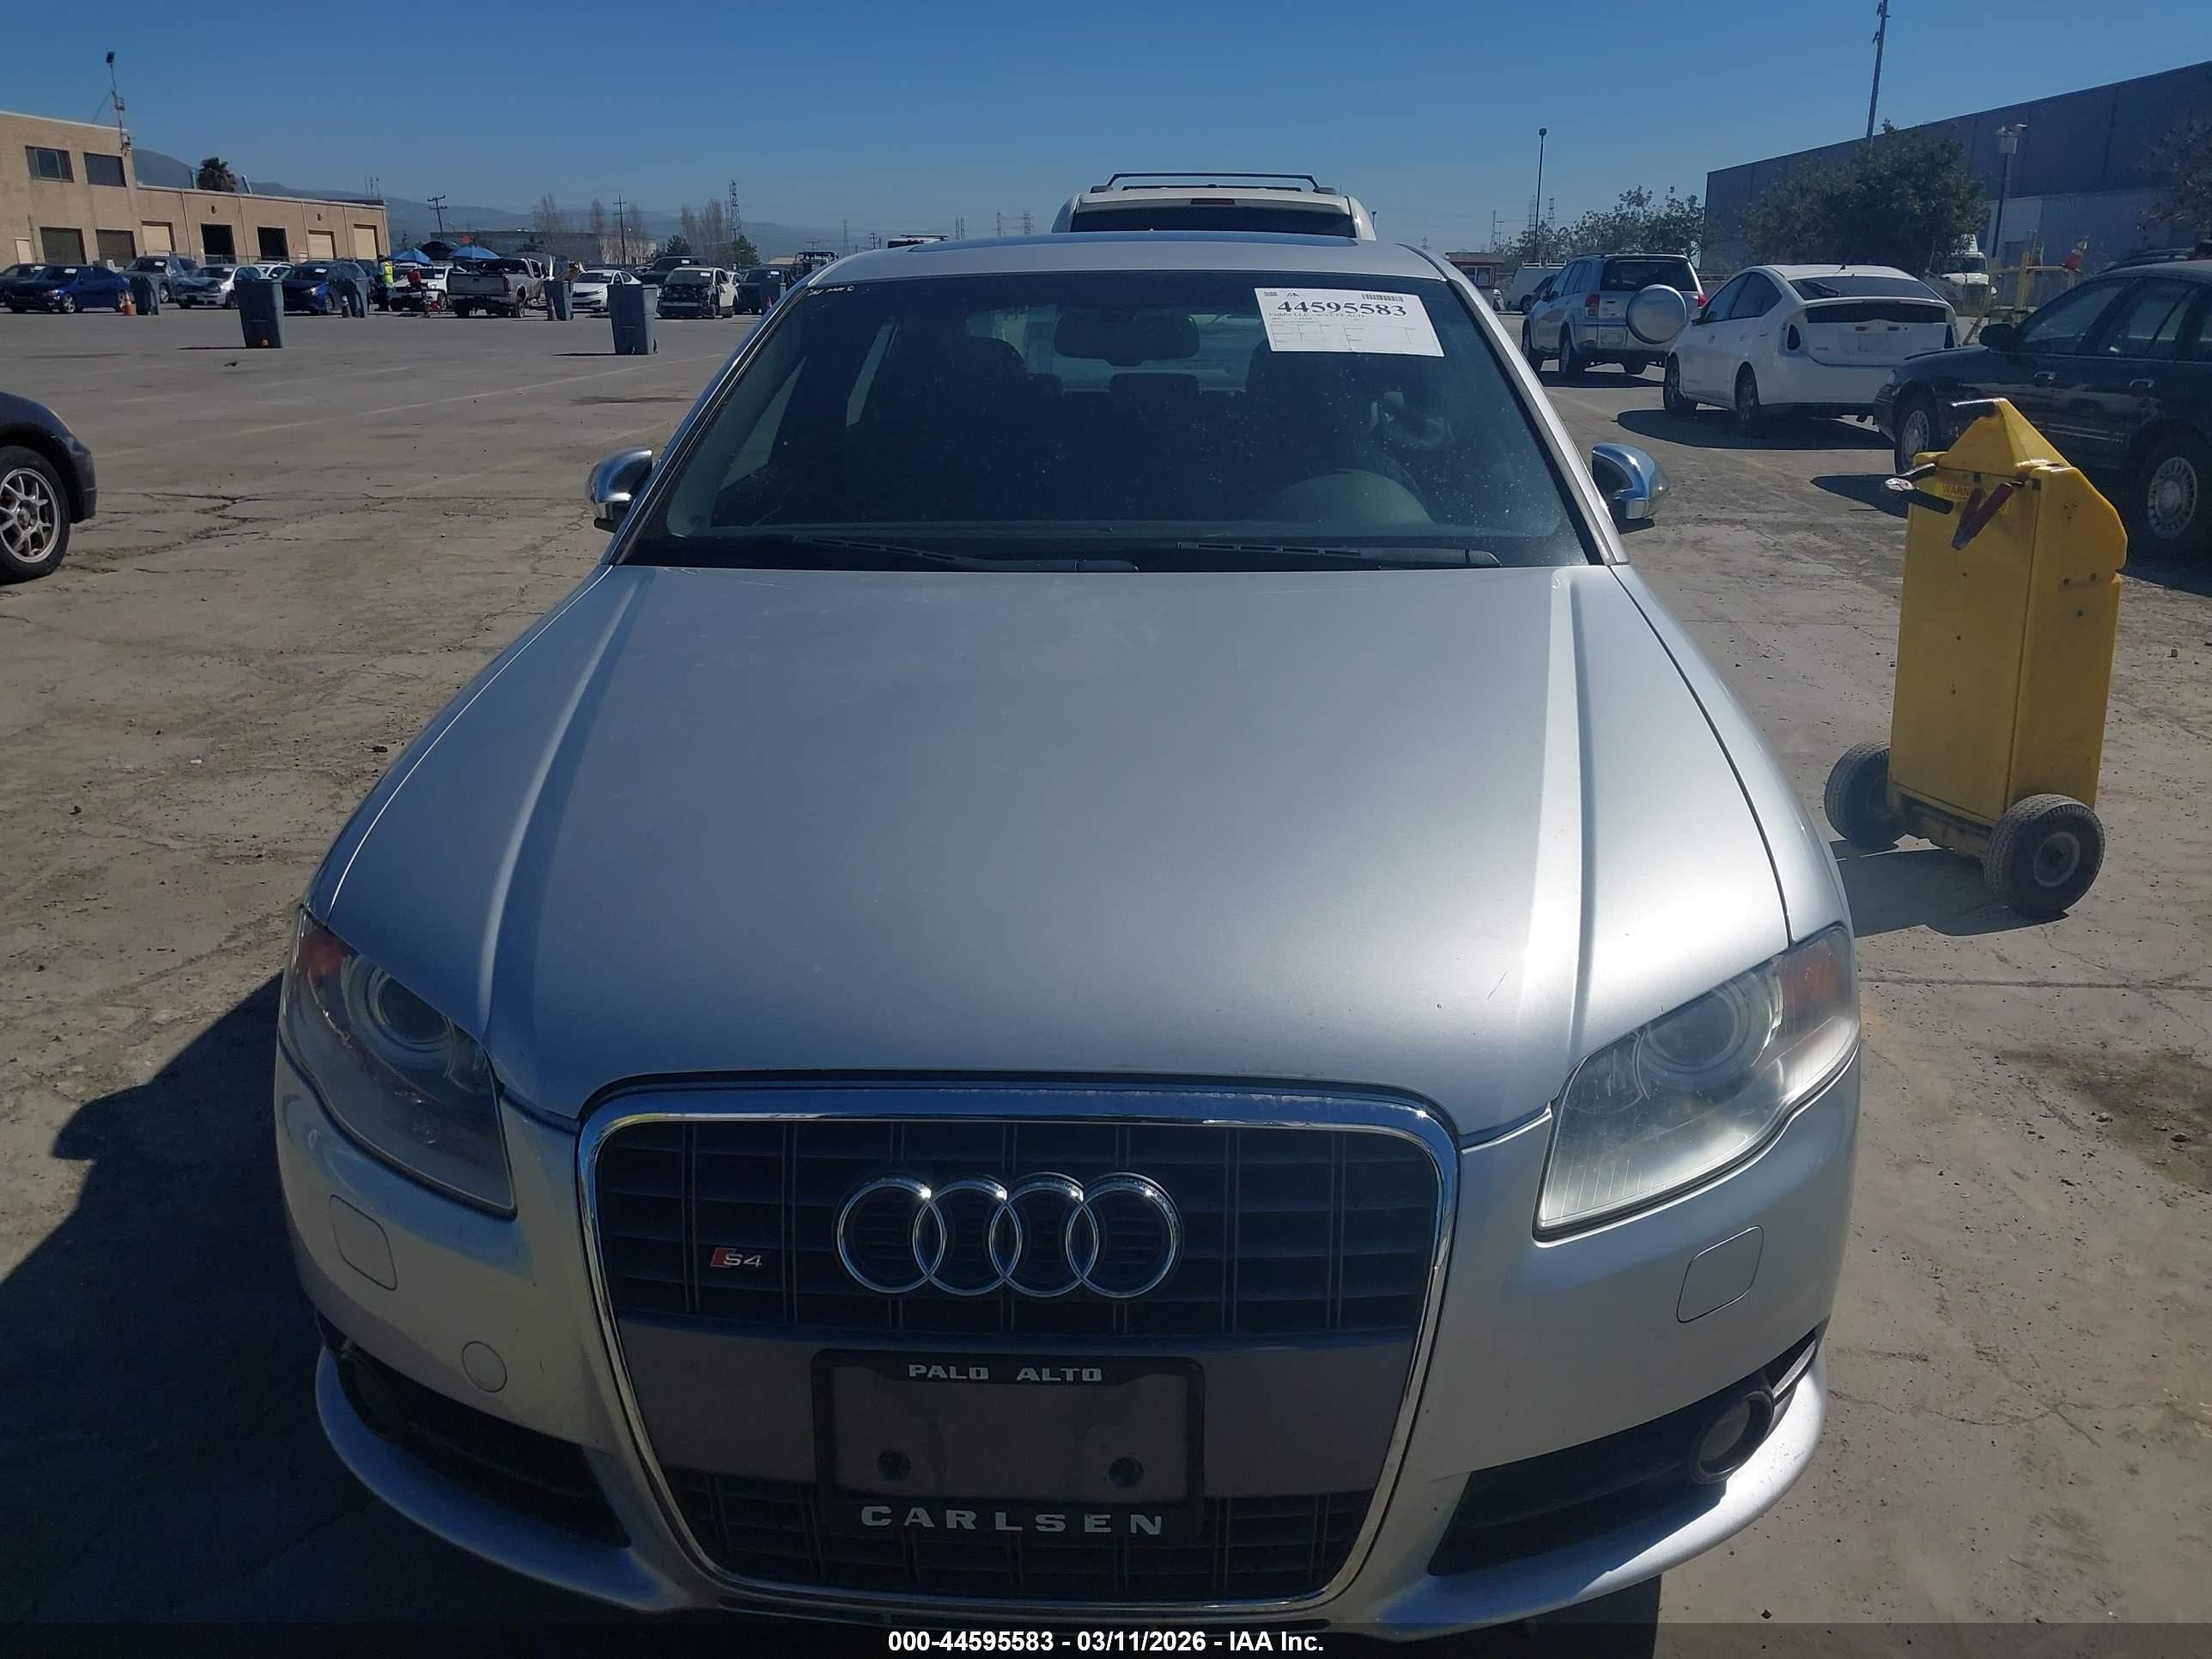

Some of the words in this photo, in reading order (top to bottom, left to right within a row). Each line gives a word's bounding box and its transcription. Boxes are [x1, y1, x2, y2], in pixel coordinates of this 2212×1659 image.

[1277, 301, 1407, 317] 44595583
[1942, 483, 1971, 496] WARN
[723, 1253, 763, 1267] S4
[908, 1364, 989, 1380] PALO
[1017, 1367, 1103, 1382] ALTO
[860, 1505, 1162, 1535] CARLSEN
